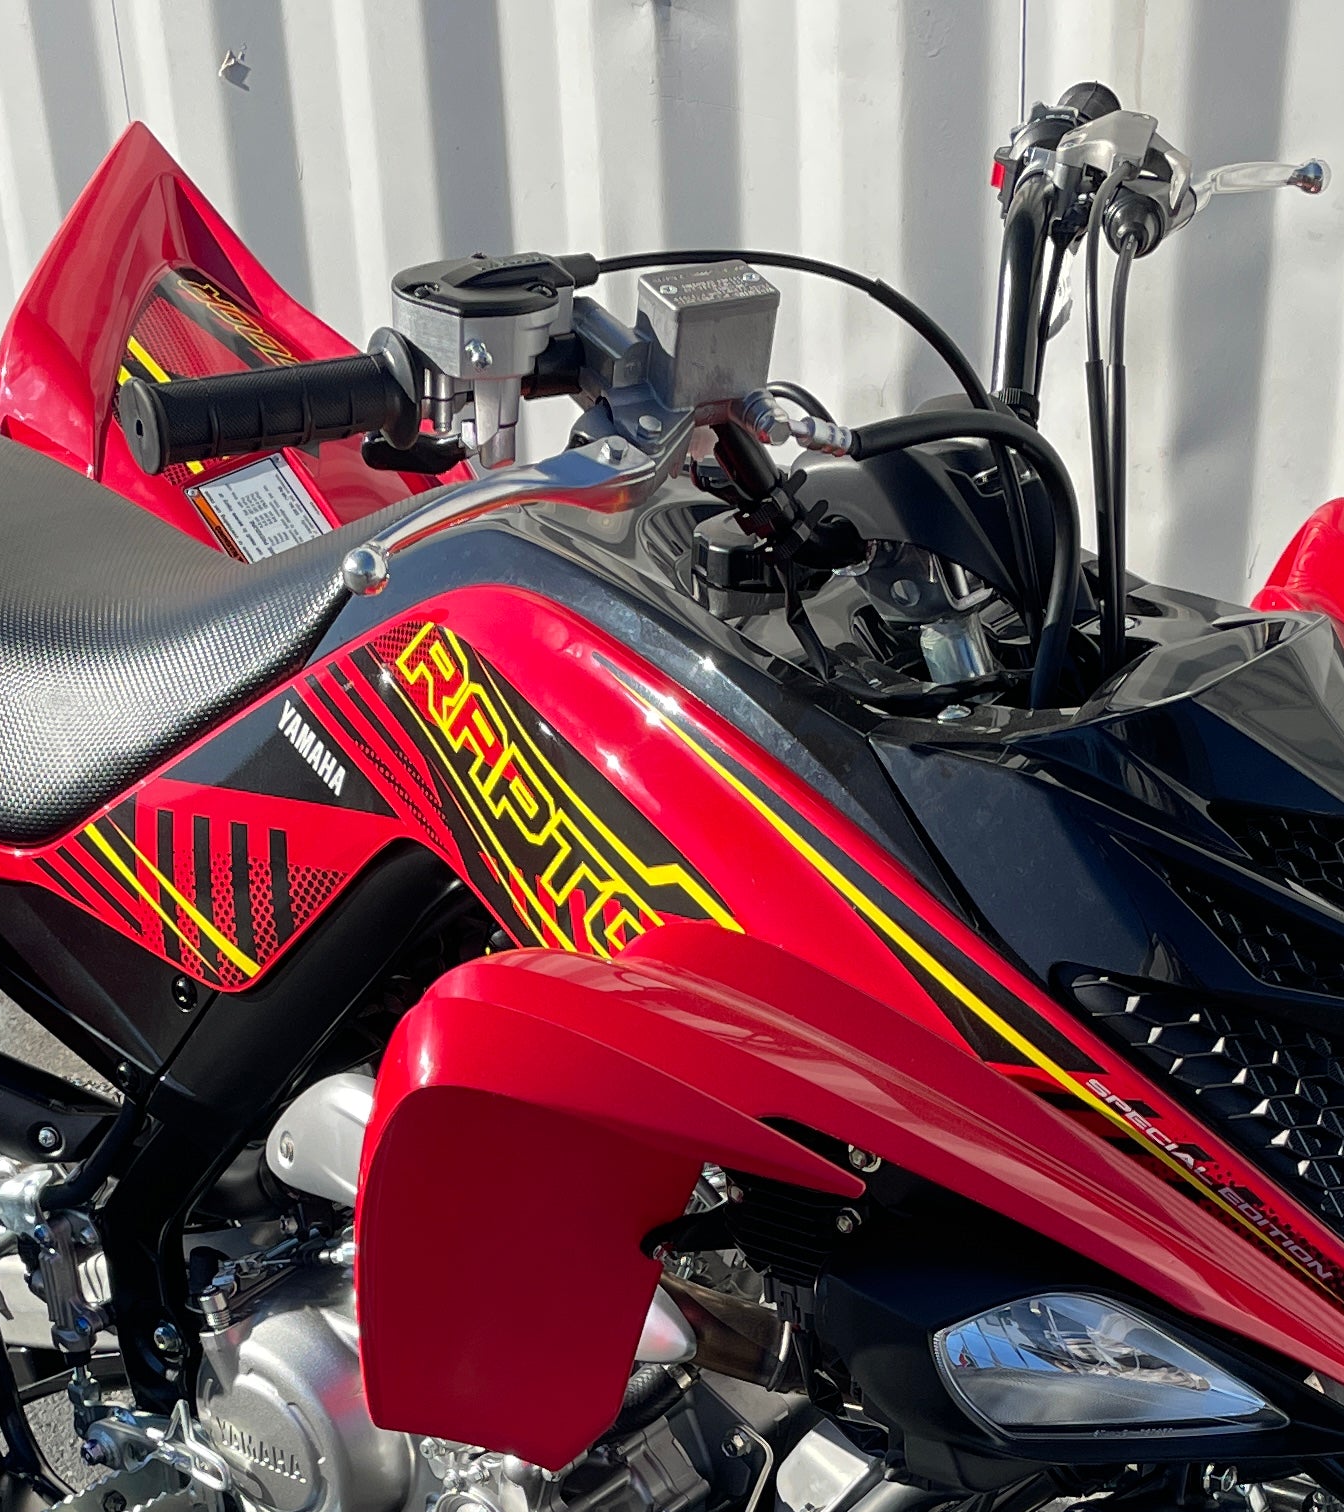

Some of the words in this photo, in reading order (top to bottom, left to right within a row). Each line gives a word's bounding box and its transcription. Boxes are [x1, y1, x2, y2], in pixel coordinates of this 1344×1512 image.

[277, 698, 347, 799] YAMAHA
[395, 621, 665, 960] RAPTO
[1086, 1078, 1213, 1186] SPECIAL
[1218, 1186, 1334, 1280] EDITION
[216, 1416, 307, 1484] YAMAHA
